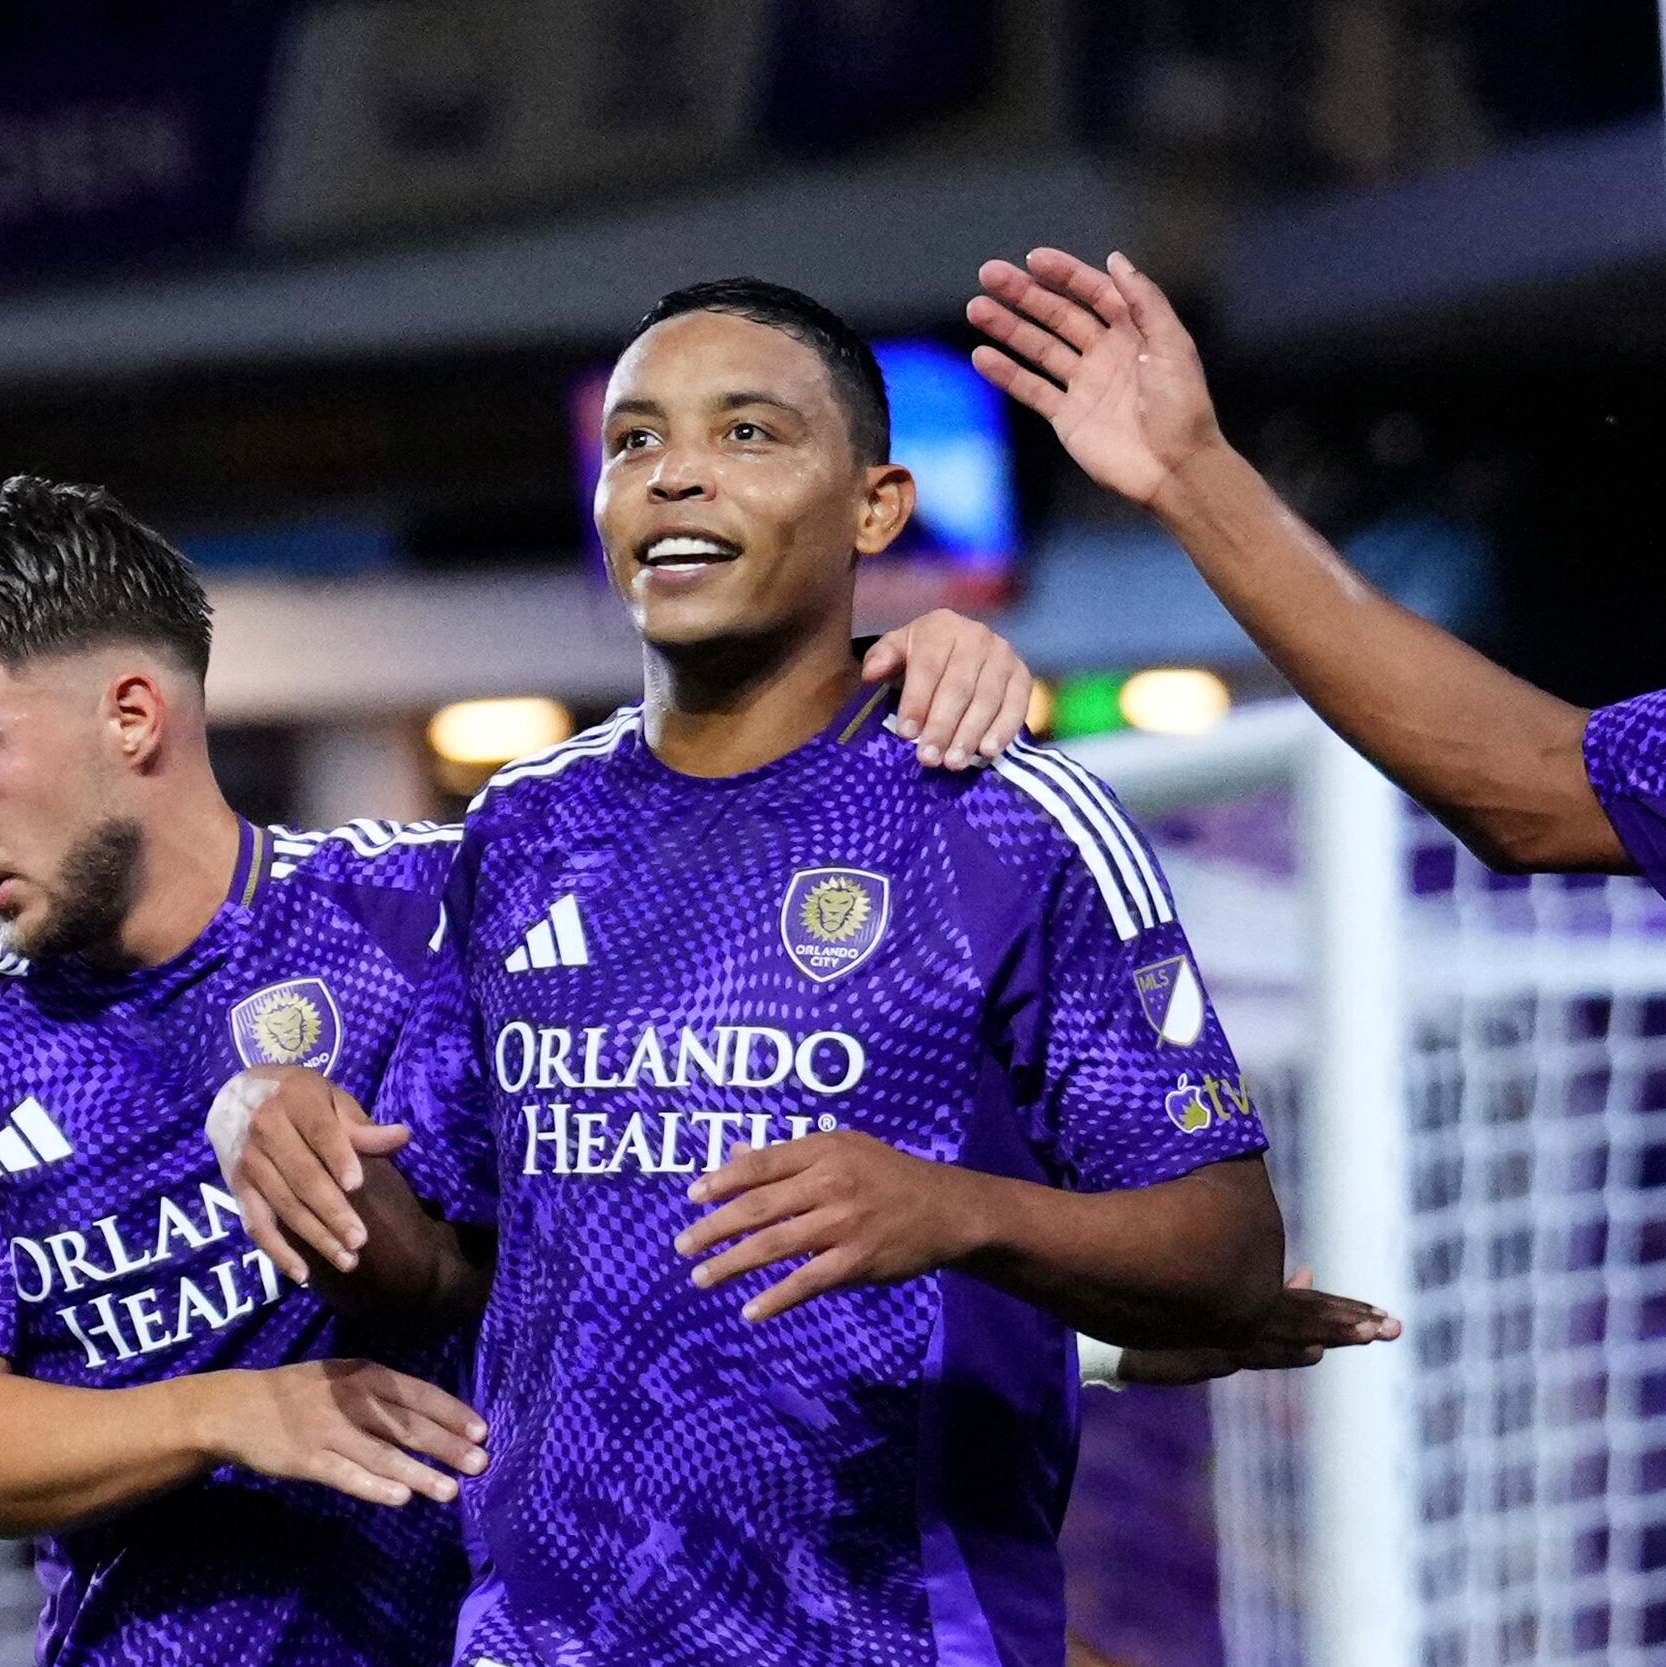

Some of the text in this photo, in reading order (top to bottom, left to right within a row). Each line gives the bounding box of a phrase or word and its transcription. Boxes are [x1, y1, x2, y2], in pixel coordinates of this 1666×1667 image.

[795, 944, 859, 959] ORLANDO
[810, 956, 840, 968] CITY
[1137, 969, 1170, 993] MLS
[495, 1020, 866, 1094] ORLANDO
[1202, 1073, 1251, 1121] tv
[9, 1182, 244, 1303] ORLAN
[55, 1249, 309, 1369] HEALT
